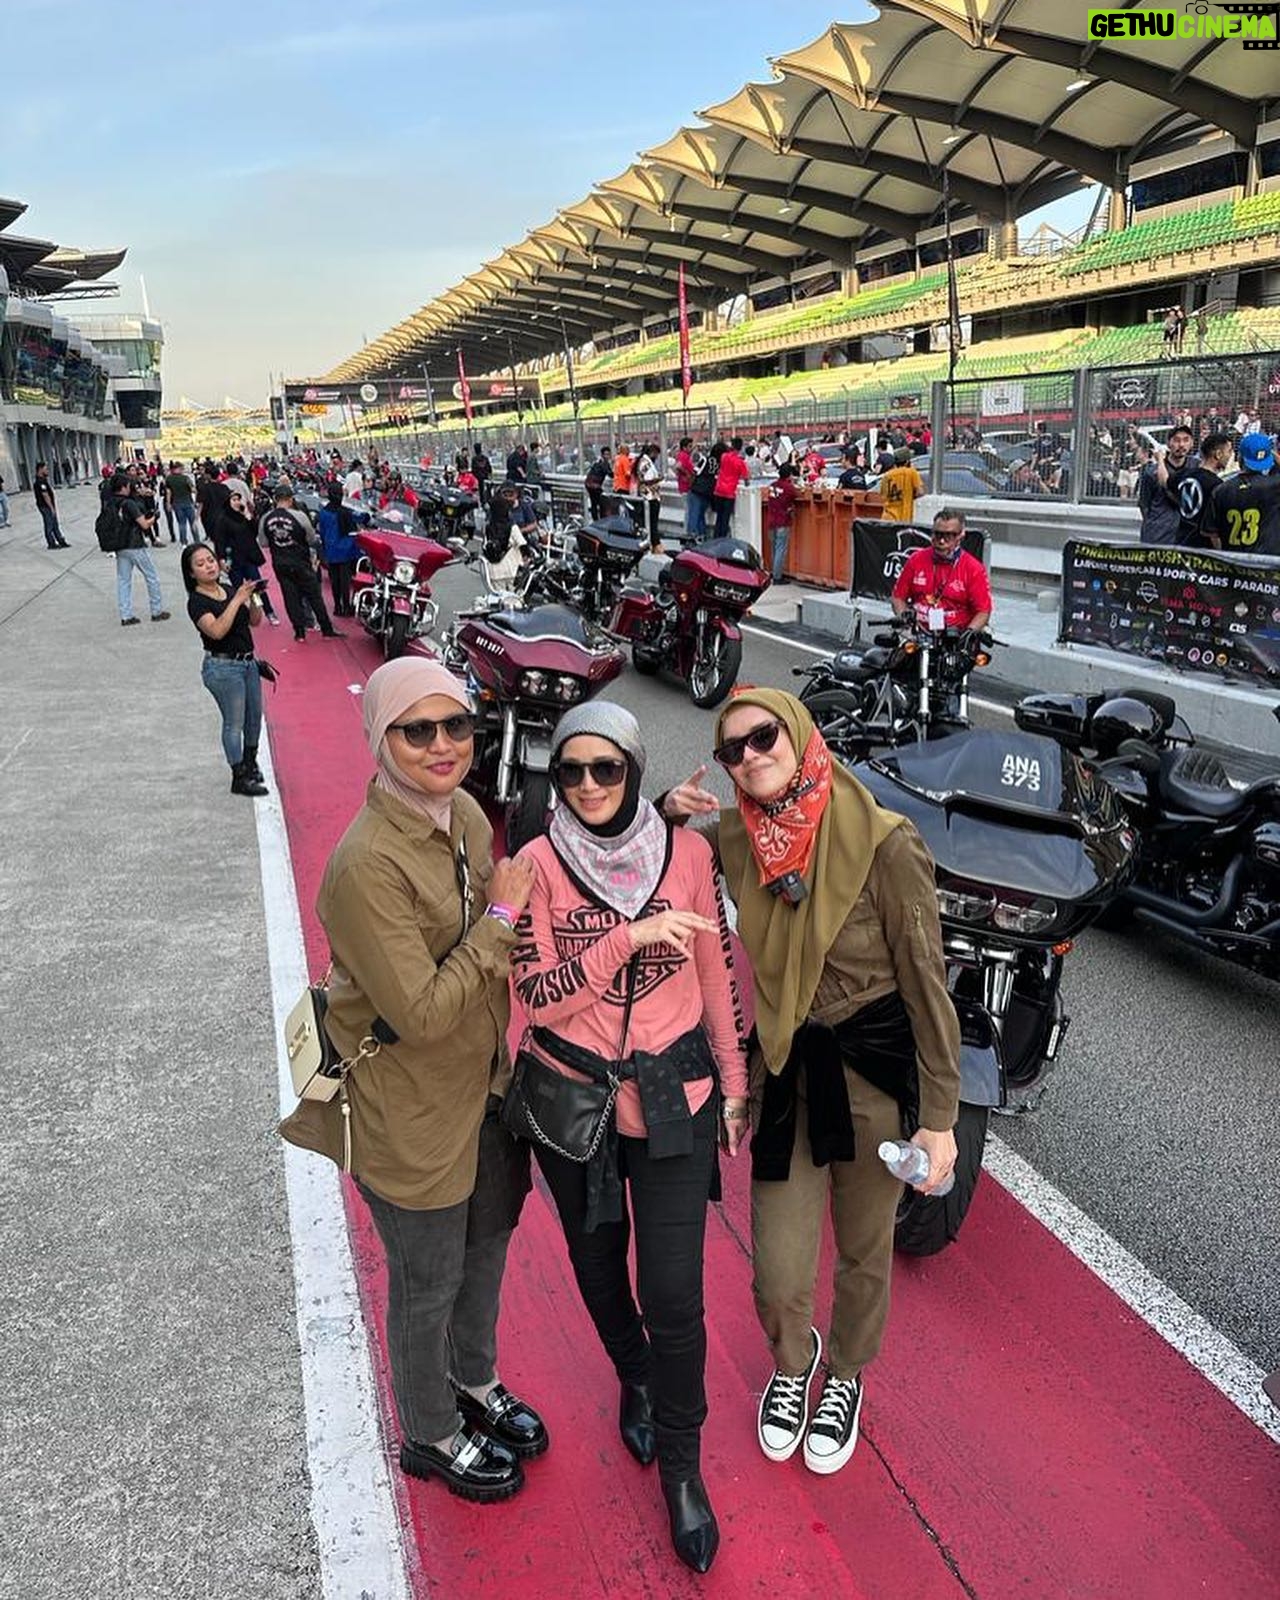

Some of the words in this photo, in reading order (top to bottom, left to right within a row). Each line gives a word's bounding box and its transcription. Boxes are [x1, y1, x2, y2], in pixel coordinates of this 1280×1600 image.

[1227, 508, 1261, 545] 23
[1198, 574, 1229, 588] CARS
[1233, 579, 1279, 595] PARADE
[1002, 754, 1041, 776] ANA
[1001, 768, 1041, 791] 373
